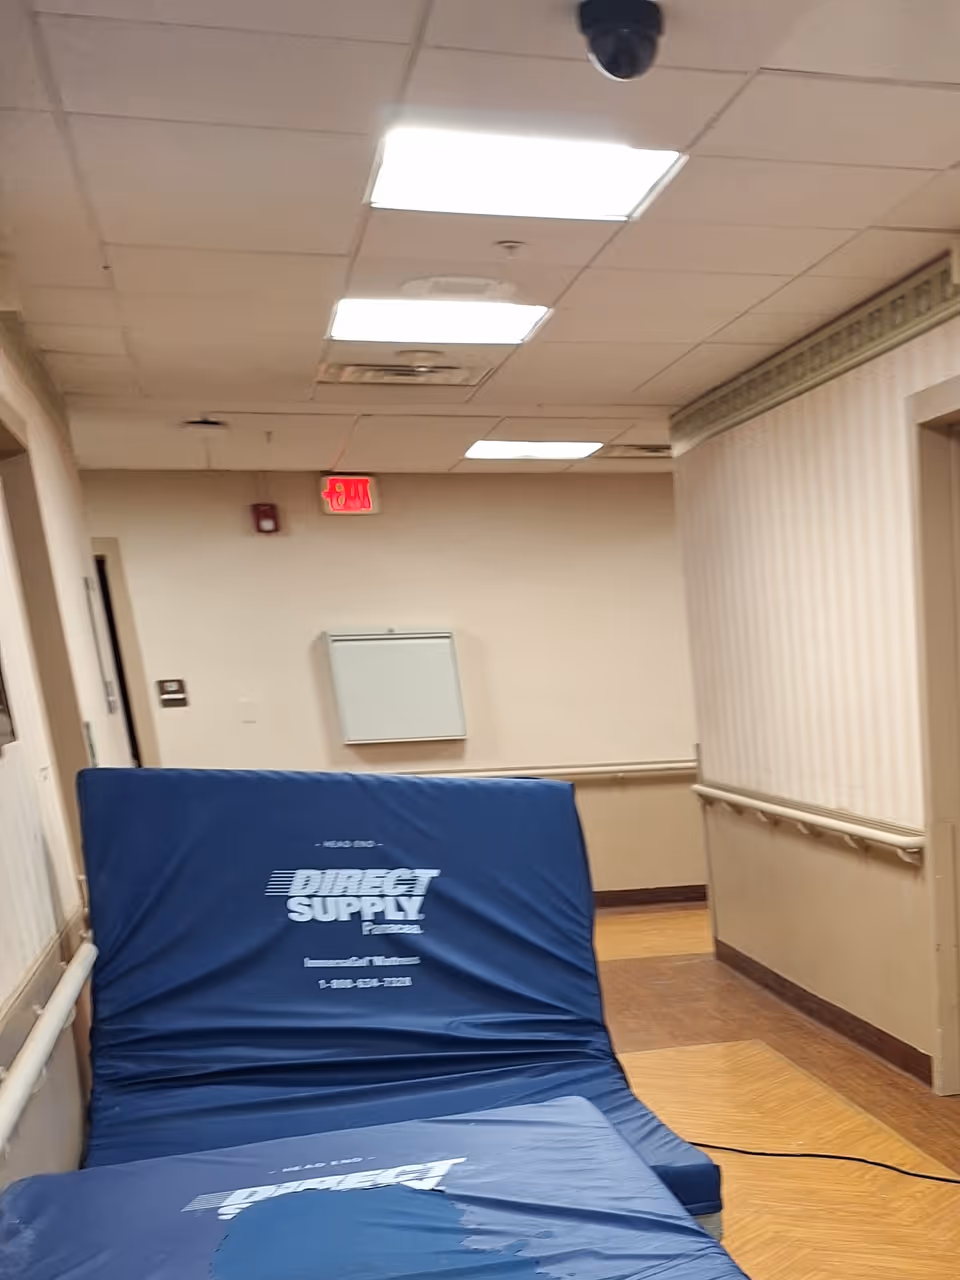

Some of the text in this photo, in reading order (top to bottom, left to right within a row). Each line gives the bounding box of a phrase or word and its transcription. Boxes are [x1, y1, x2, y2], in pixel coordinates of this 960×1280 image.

[284, 867, 441, 896] DIRECT
[286, 896, 425, 922] SUPPLY
[282, 1157, 363, 1173] HEAD END
